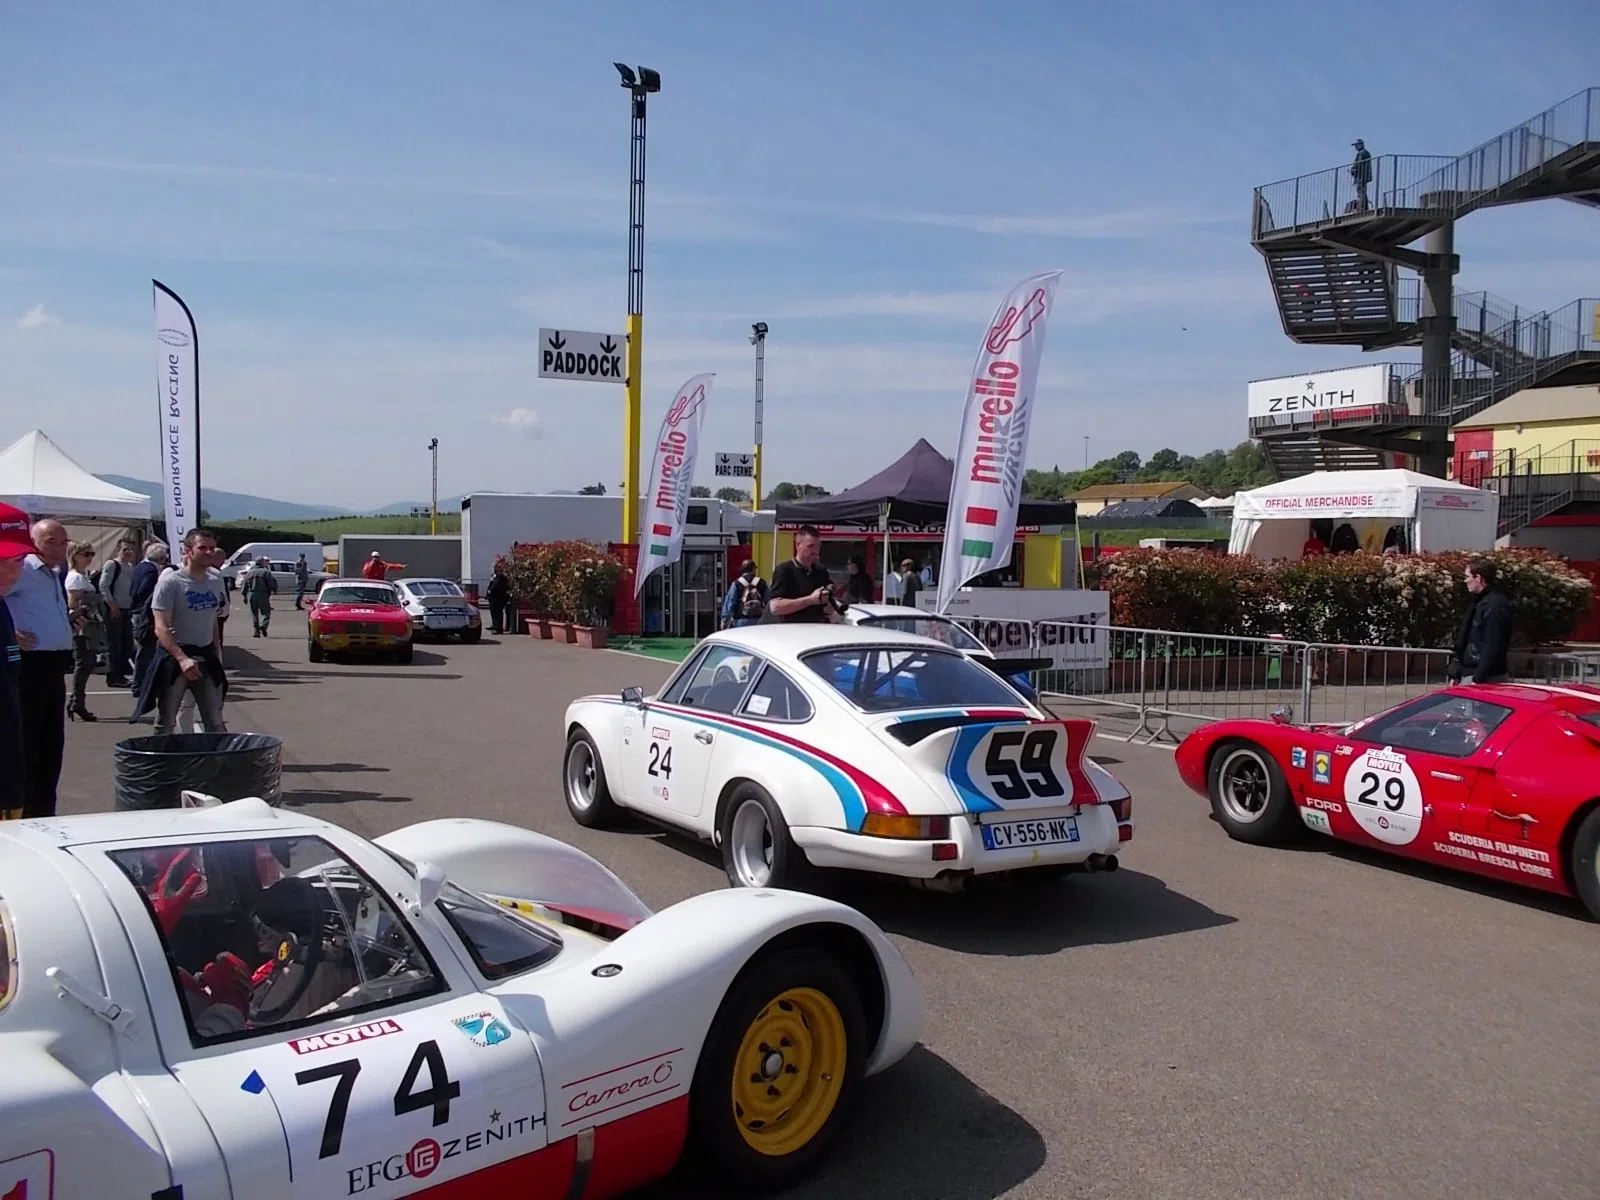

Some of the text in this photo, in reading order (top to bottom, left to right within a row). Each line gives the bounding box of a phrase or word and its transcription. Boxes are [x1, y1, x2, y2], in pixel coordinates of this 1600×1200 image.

[543, 350, 621, 378] PADDOCK
[1269, 389, 1354, 412] ZENITH
[970, 361, 1019, 485] mugello
[655, 431, 687, 511] mugello
[715, 464, 731, 476] PARC
[1265, 495, 1374, 509] OFFICIAL MERCHANDISE
[648, 742, 672, 780] 24
[985, 730, 1065, 800] 59
[1368, 758, 1402, 773] MOTUL
[1306, 797, 1342, 812] FORD
[1358, 772, 1405, 811] 29
[1433, 842, 1554, 879] SCUDERIA BRESCIA CORSE
[1448, 831, 1550, 863] SCUDERIA FILIPINETTI
[297, 1021, 399, 1054] MOTUL
[295, 1040, 461, 1160] 74
[568, 1073, 653, 1112] Carrera
[442, 1112, 547, 1160] ZENITH
